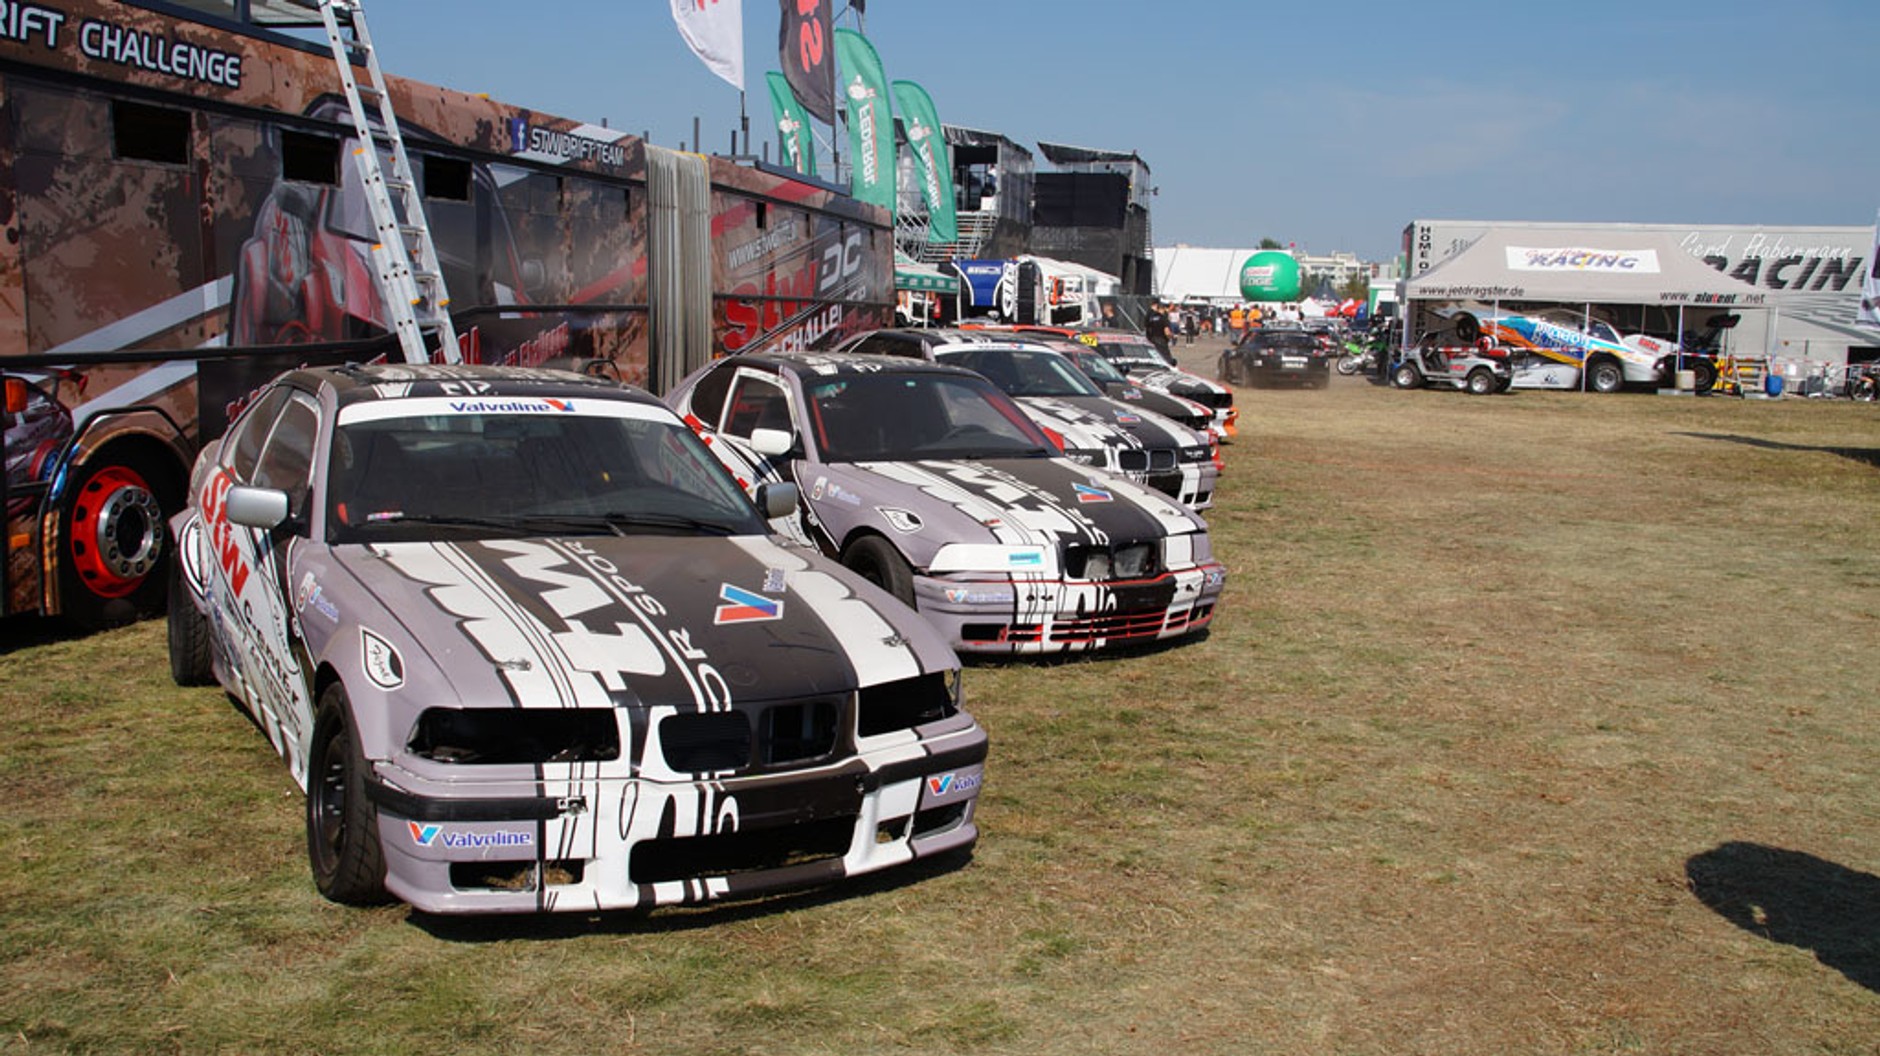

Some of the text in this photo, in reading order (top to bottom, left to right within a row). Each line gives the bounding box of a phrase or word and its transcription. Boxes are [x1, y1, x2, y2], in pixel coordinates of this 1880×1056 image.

[80, 21, 241, 87] CHALLENGE
[1528, 253, 1639, 270] RACING
[1702, 255, 1866, 292] ACIN
[449, 400, 550, 413] Valvoline
[442, 831, 531, 847] Valvoline
